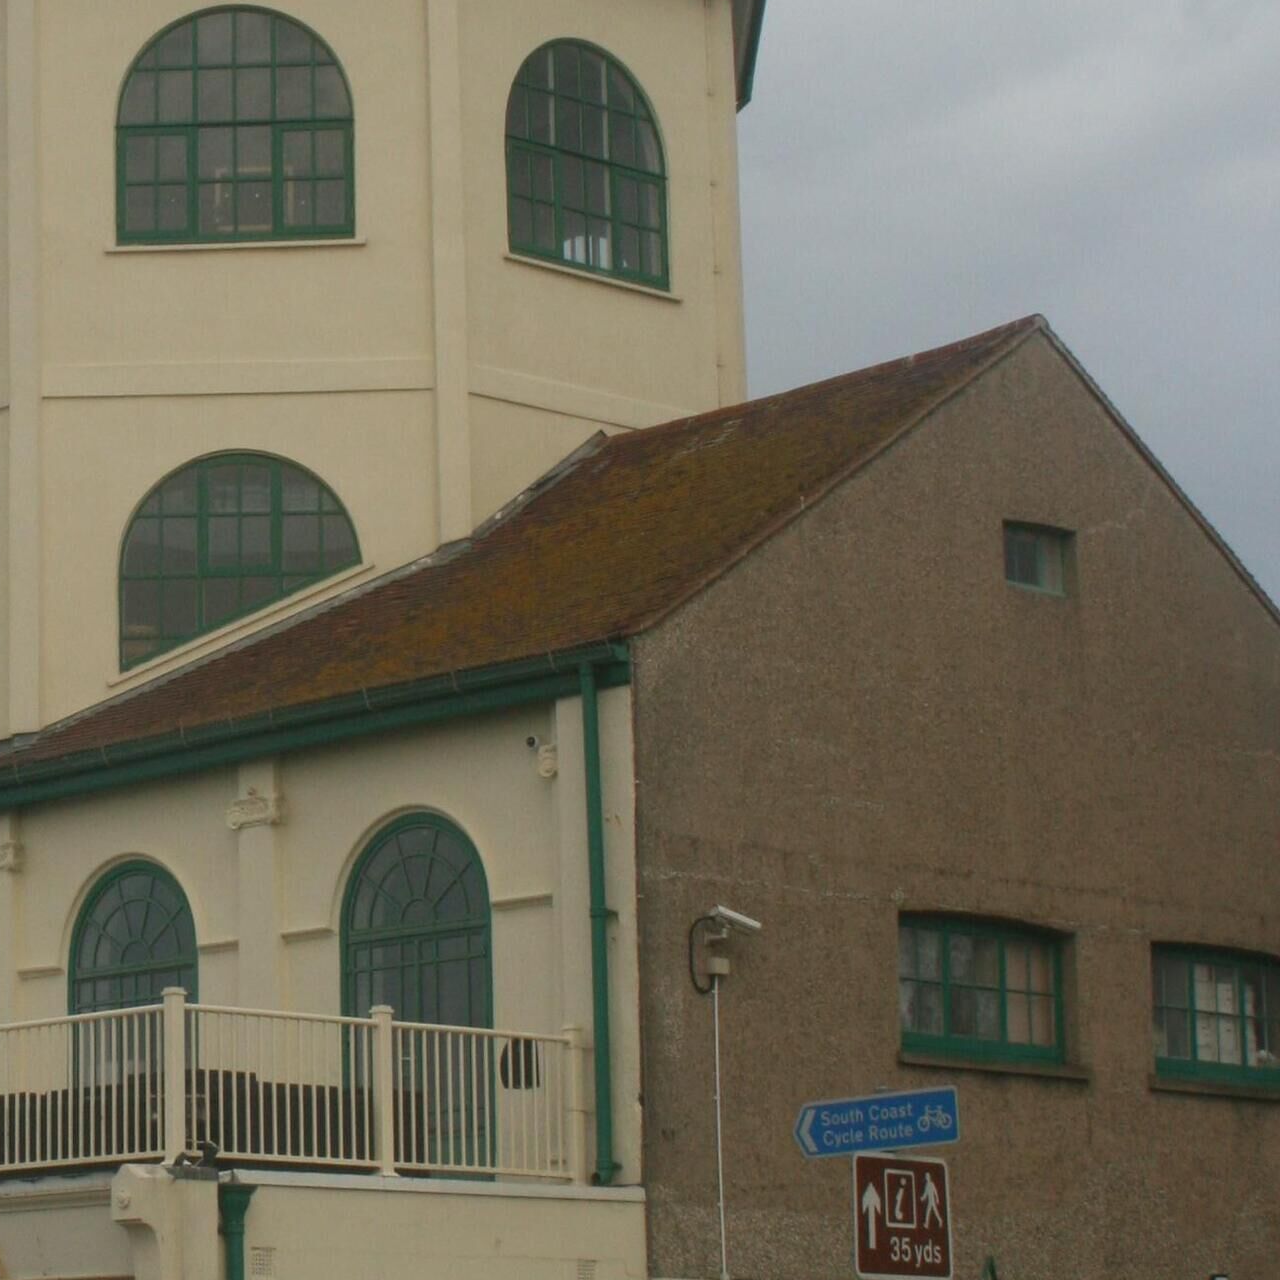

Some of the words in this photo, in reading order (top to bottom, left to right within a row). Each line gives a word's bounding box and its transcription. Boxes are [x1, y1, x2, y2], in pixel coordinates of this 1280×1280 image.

[821, 1107, 863, 1126] South
[869, 1103, 913, 1121] Coast
[823, 1128, 864, 1147] Cycle
[870, 1123, 914, 1141] Route
[890, 1236, 912, 1262] 35
[915, 1239, 942, 1268] yds
